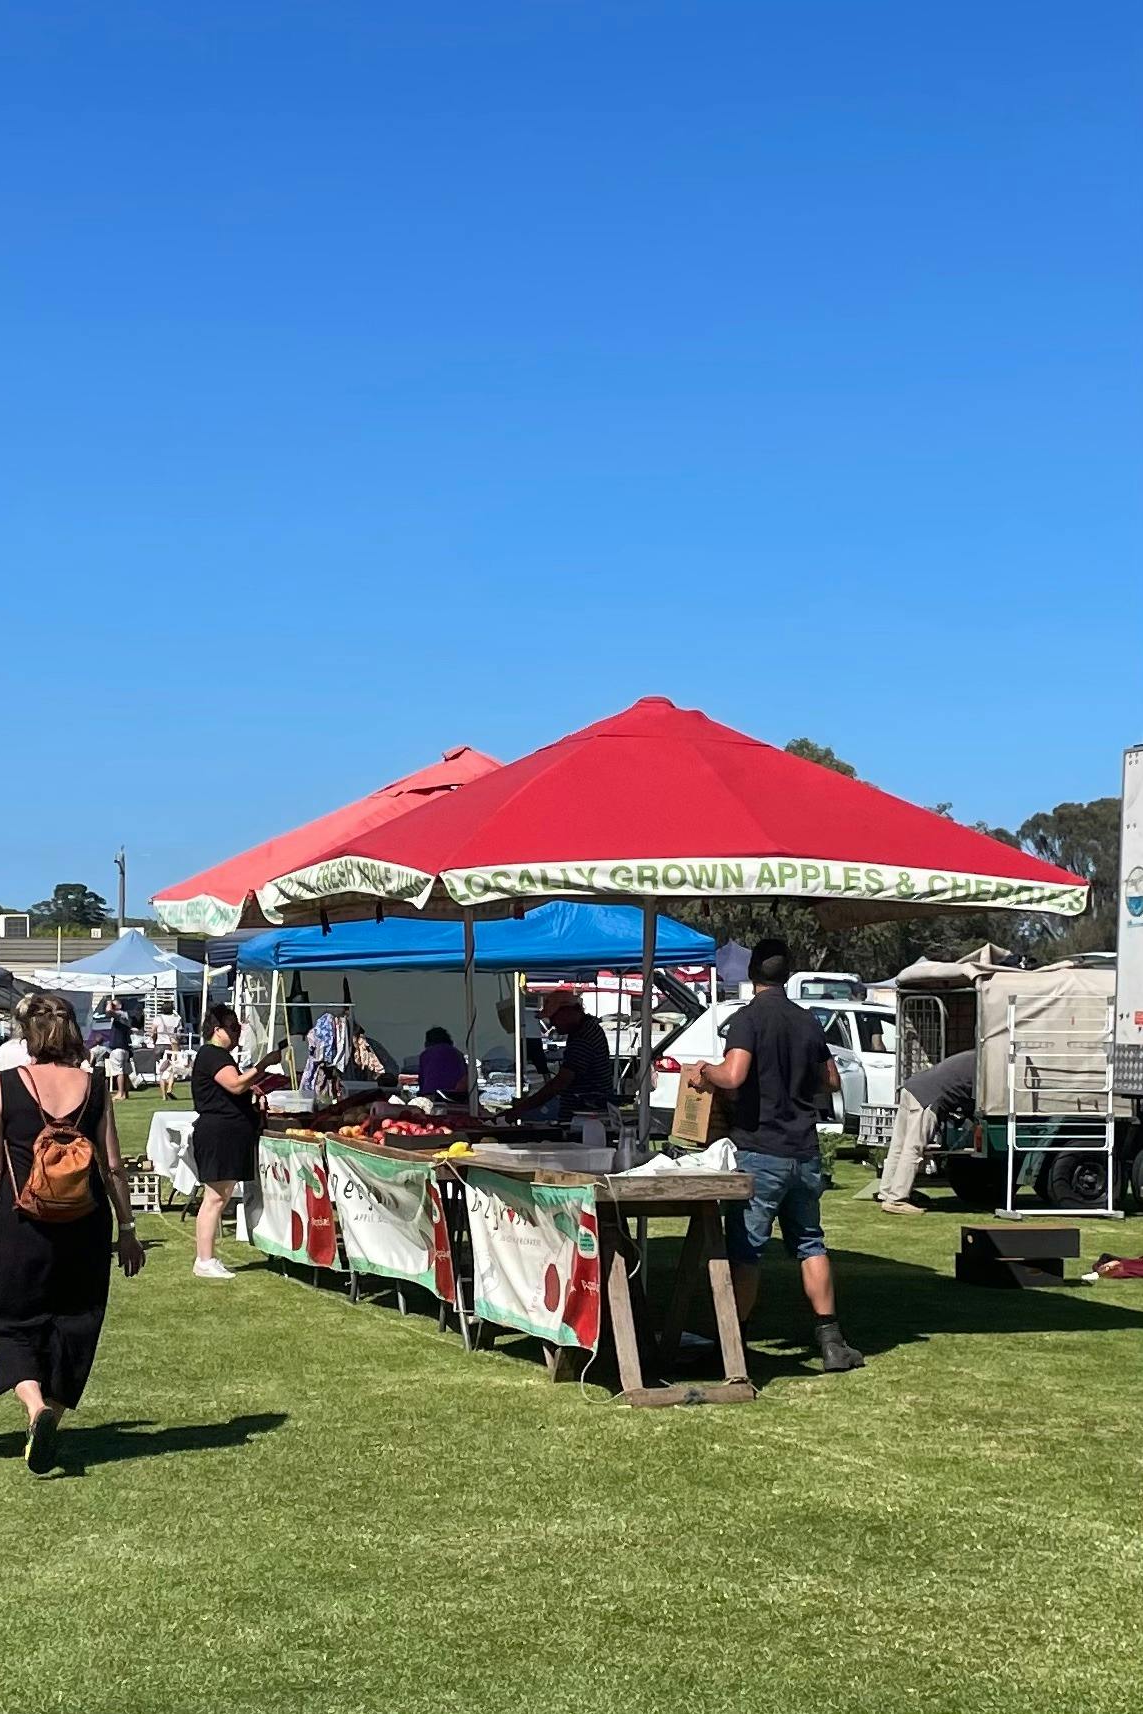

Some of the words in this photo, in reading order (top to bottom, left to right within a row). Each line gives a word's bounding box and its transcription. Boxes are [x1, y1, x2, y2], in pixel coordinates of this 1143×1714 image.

[316, 858, 356, 892] FRESH
[446, 866, 597, 901] LOCALLY
[609, 861, 745, 891] GROWN
[757, 862, 884, 893] APPLES
[895, 871, 916, 896] &
